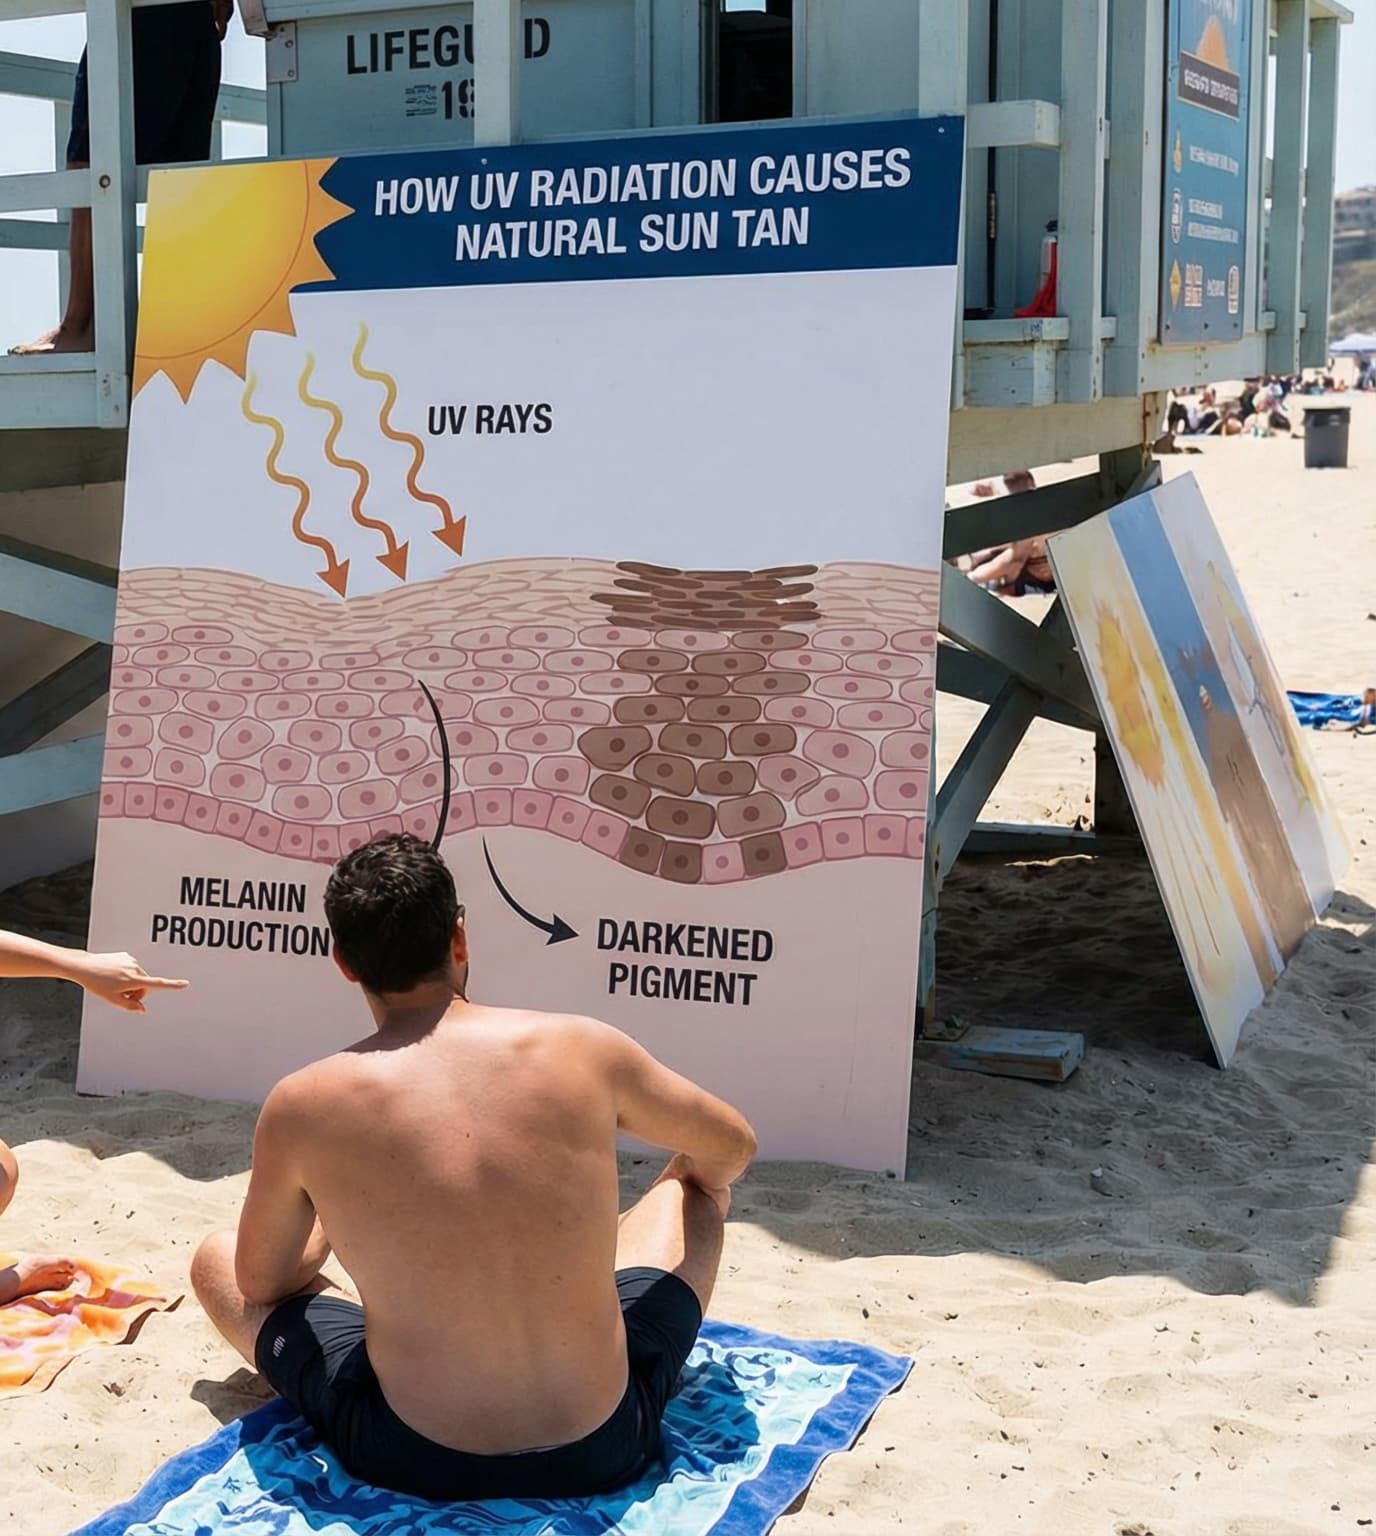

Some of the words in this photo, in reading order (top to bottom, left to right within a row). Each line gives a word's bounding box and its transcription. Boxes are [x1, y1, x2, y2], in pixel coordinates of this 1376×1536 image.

[374, 175, 460, 216] HOW
[470, 171, 520, 210] UV
[530, 158, 737, 207] RADIATION
[750, 147, 911, 195] CAUSES
[455, 216, 627, 261] NATURAL
[639, 211, 719, 253] SUN
[731, 206, 810, 248] TAN
[428, 405, 468, 436] UV
[475, 403, 553, 435] RAYS
[180, 876, 307, 913] MELANIN
[151, 914, 330, 957] PRODUCTION
[597, 918, 773, 963] DARKENED
[608, 962, 758, 1006] PIGMENT
